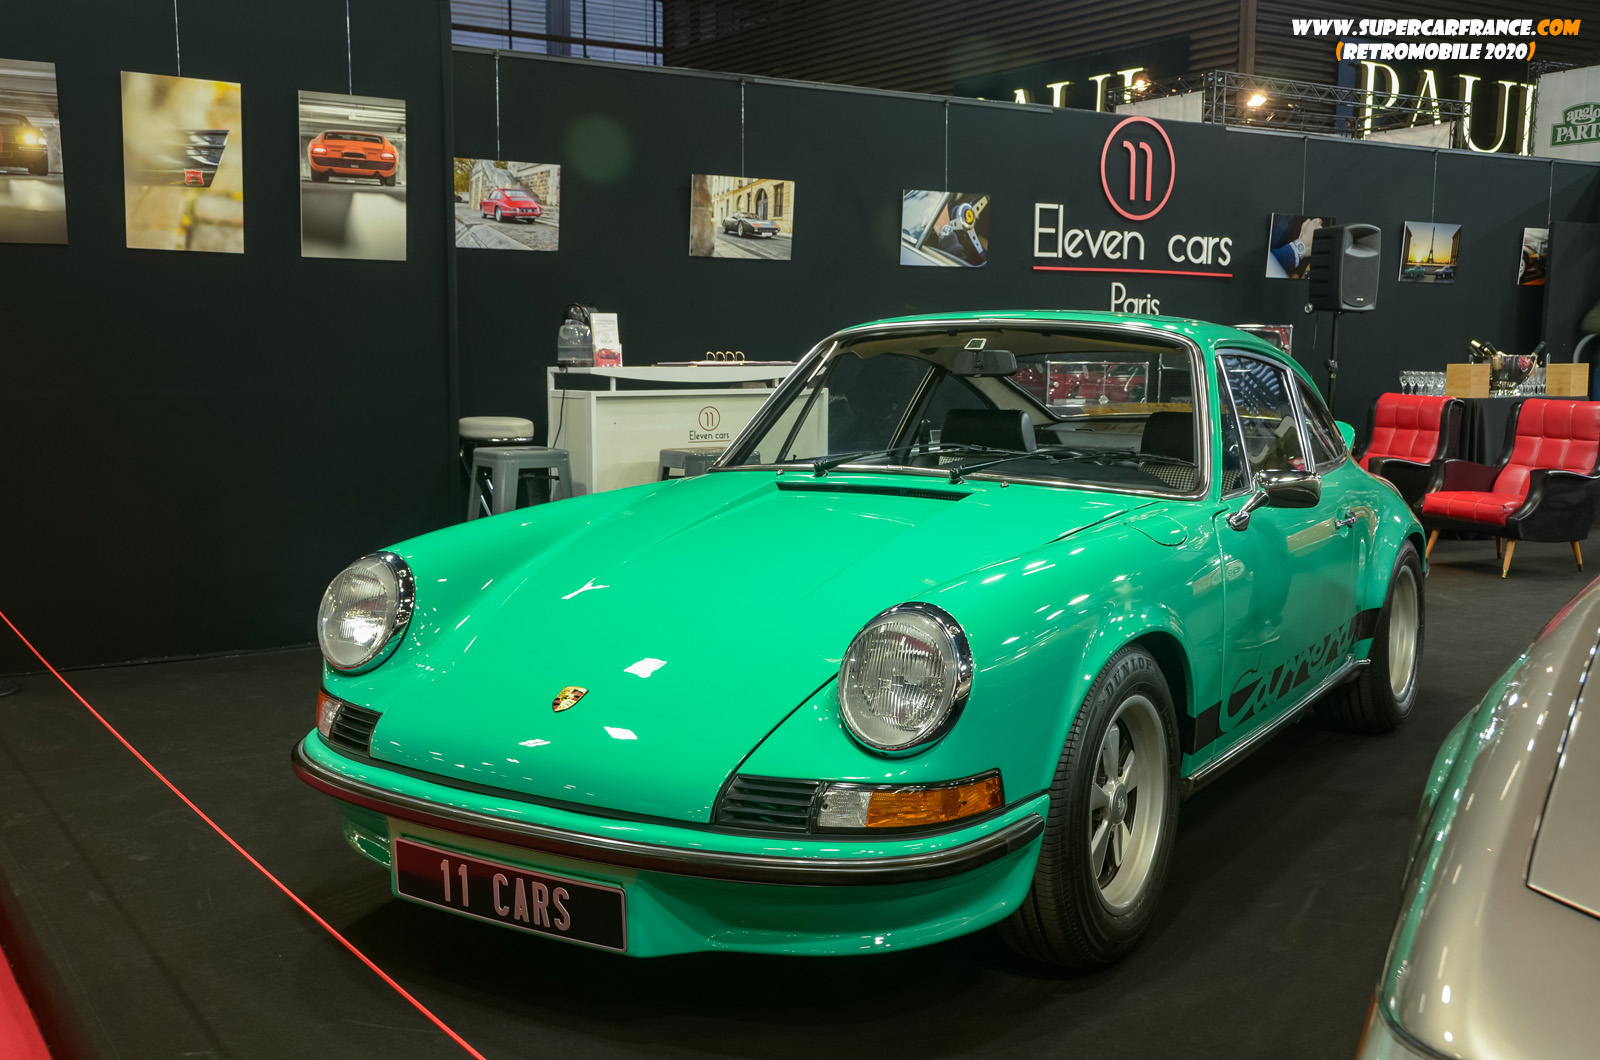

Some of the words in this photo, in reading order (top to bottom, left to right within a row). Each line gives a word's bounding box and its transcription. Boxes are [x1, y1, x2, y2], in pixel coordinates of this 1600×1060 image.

[1555, 123, 1600, 143] PART
[1123, 140, 1153, 202] 11
[1033, 202, 1145, 261] Eleven
[1167, 234, 1233, 267] cars
[1110, 281, 1160, 316] Paris
[689, 430, 713, 441] Eleven
[715, 432, 730, 440] cars
[1105, 657, 1153, 697] DUNLOP
[1219, 618, 1357, 733] Carrera
[440, 859, 469, 908] 11
[492, 873, 571, 932] CARS
